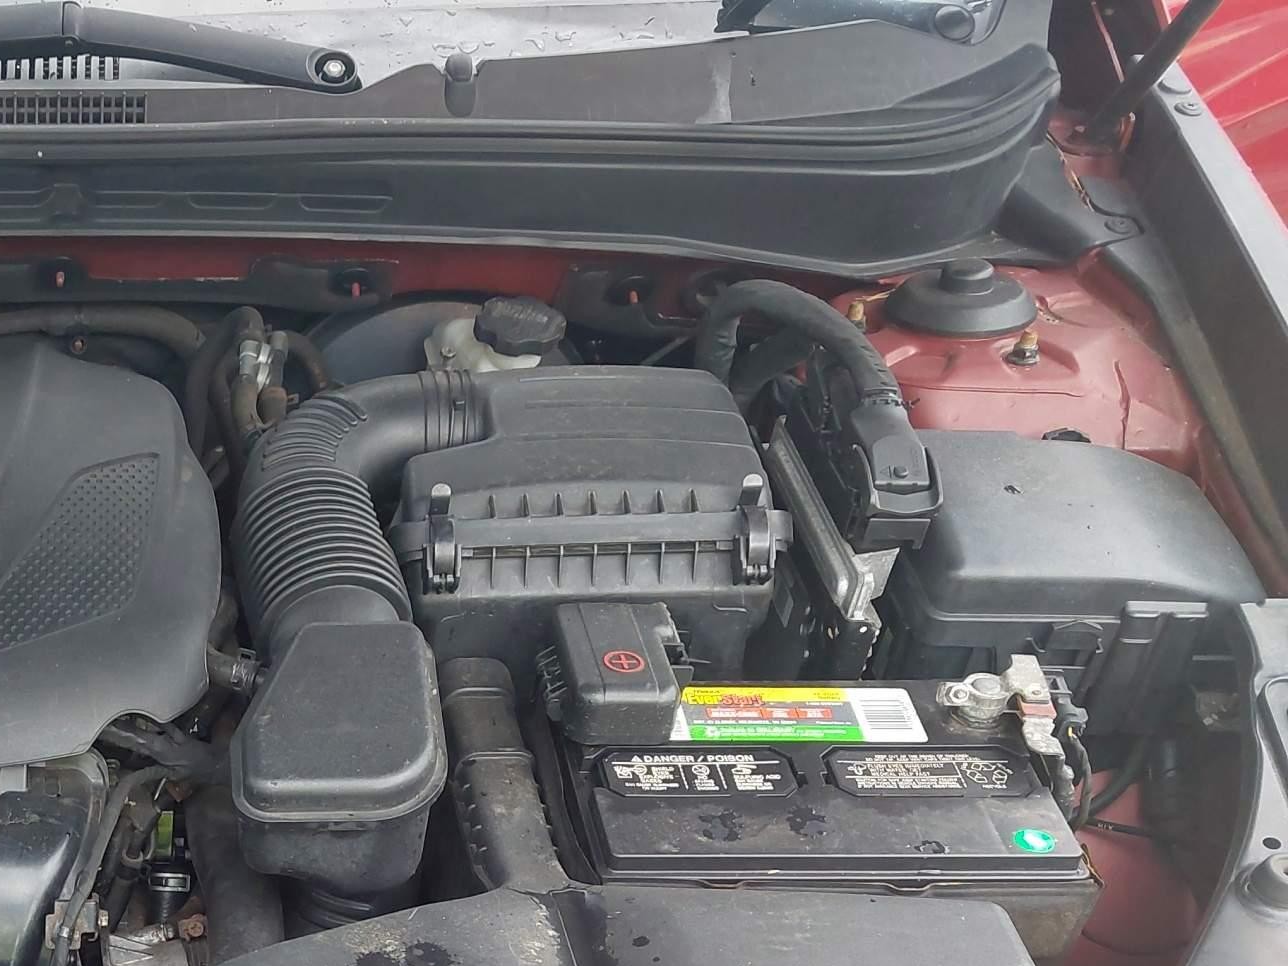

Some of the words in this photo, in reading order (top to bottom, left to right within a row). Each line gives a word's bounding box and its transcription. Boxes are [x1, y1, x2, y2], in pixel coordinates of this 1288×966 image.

[643, 754, 694, 763] DANGER
[697, 754, 705, 763] /
[706, 754, 754, 762] POISON
